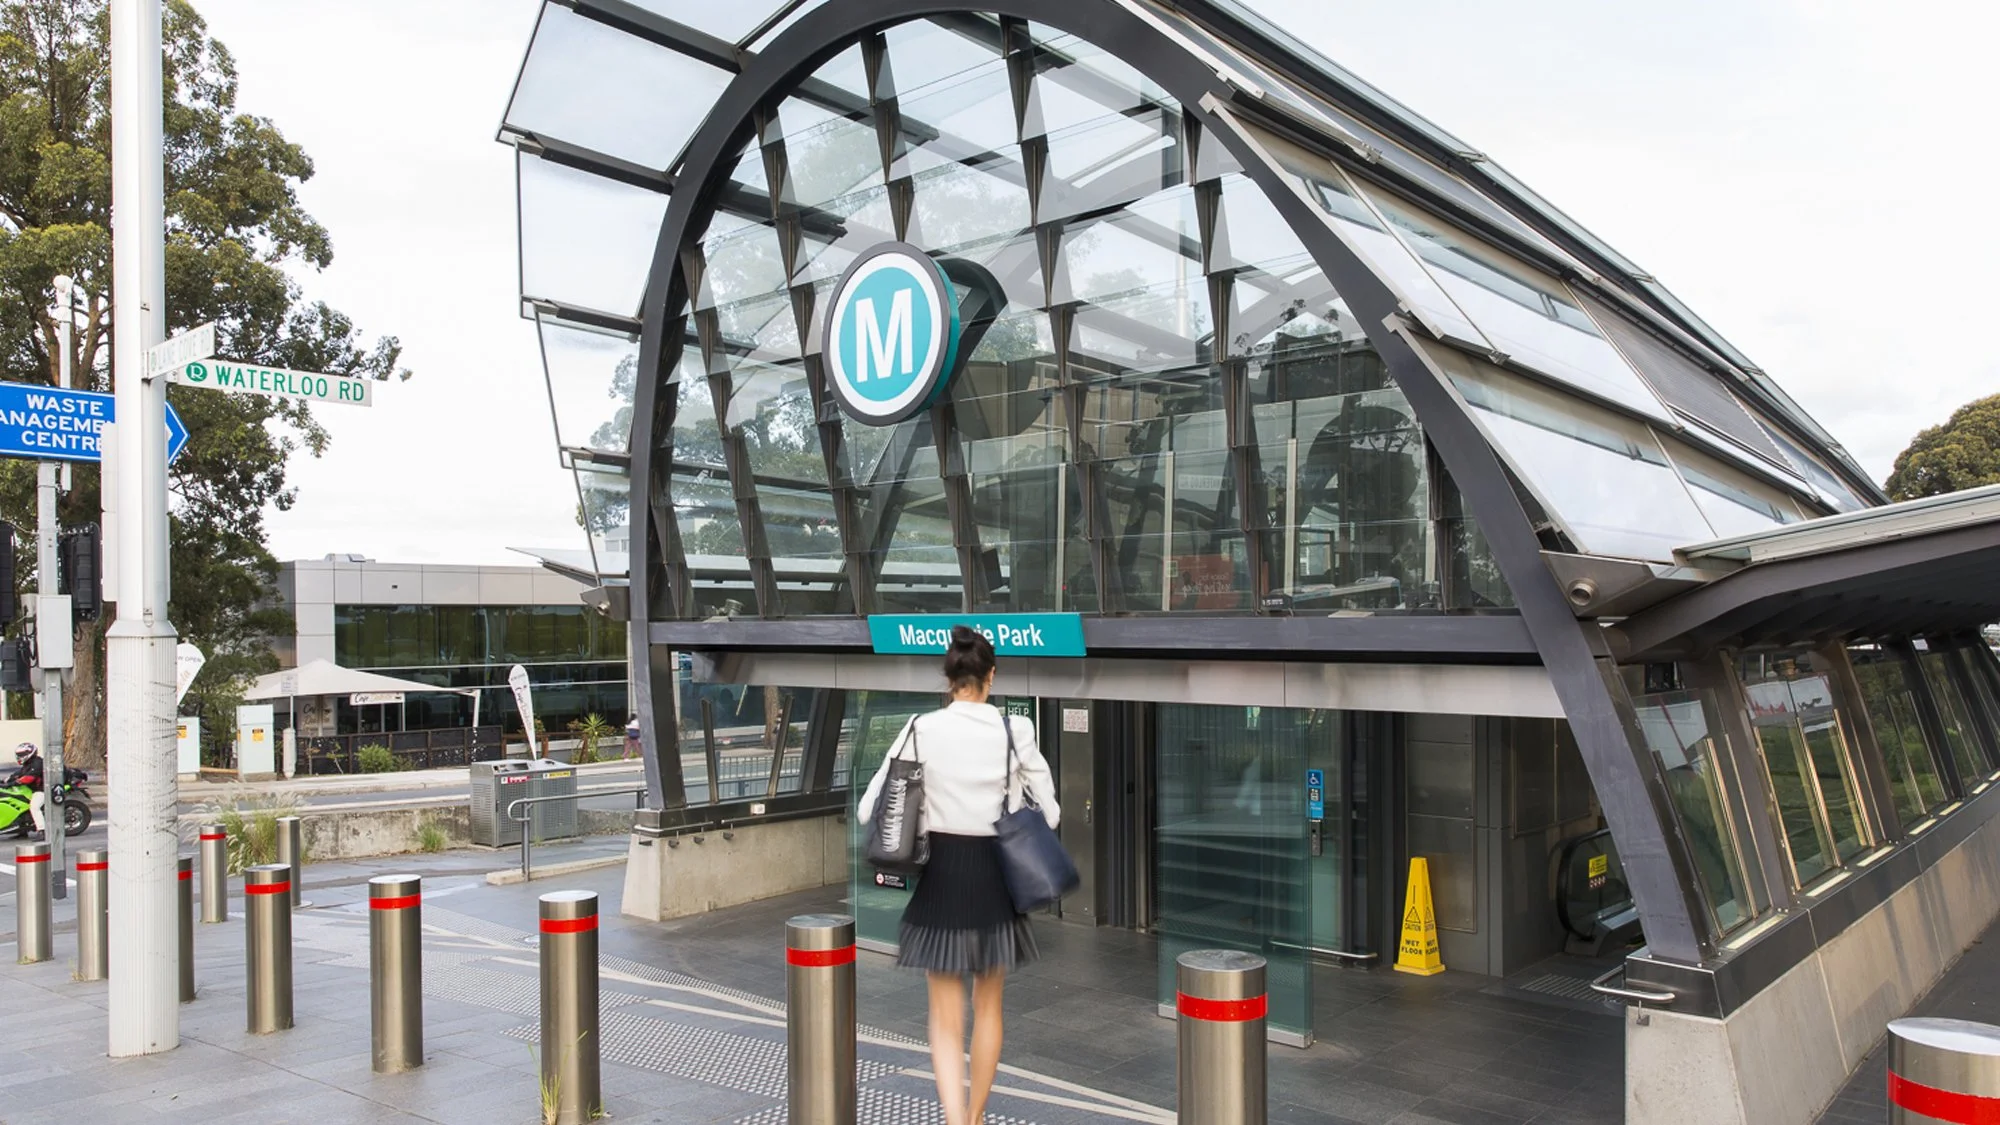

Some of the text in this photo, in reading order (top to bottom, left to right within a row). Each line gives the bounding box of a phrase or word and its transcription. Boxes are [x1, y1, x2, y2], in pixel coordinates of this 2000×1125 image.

[855, 287, 913, 384] M
[215, 365, 328, 397] WATERLOO
[339, 381, 364, 402] RD
[26, 393, 104, 417] WASTE
[0, 409, 113, 435] ANAGEME
[899, 623, 1045, 651] Macqe Park
[1007, 706, 1030, 717] HELP
[1401, 947, 1422, 955] FLOOR
